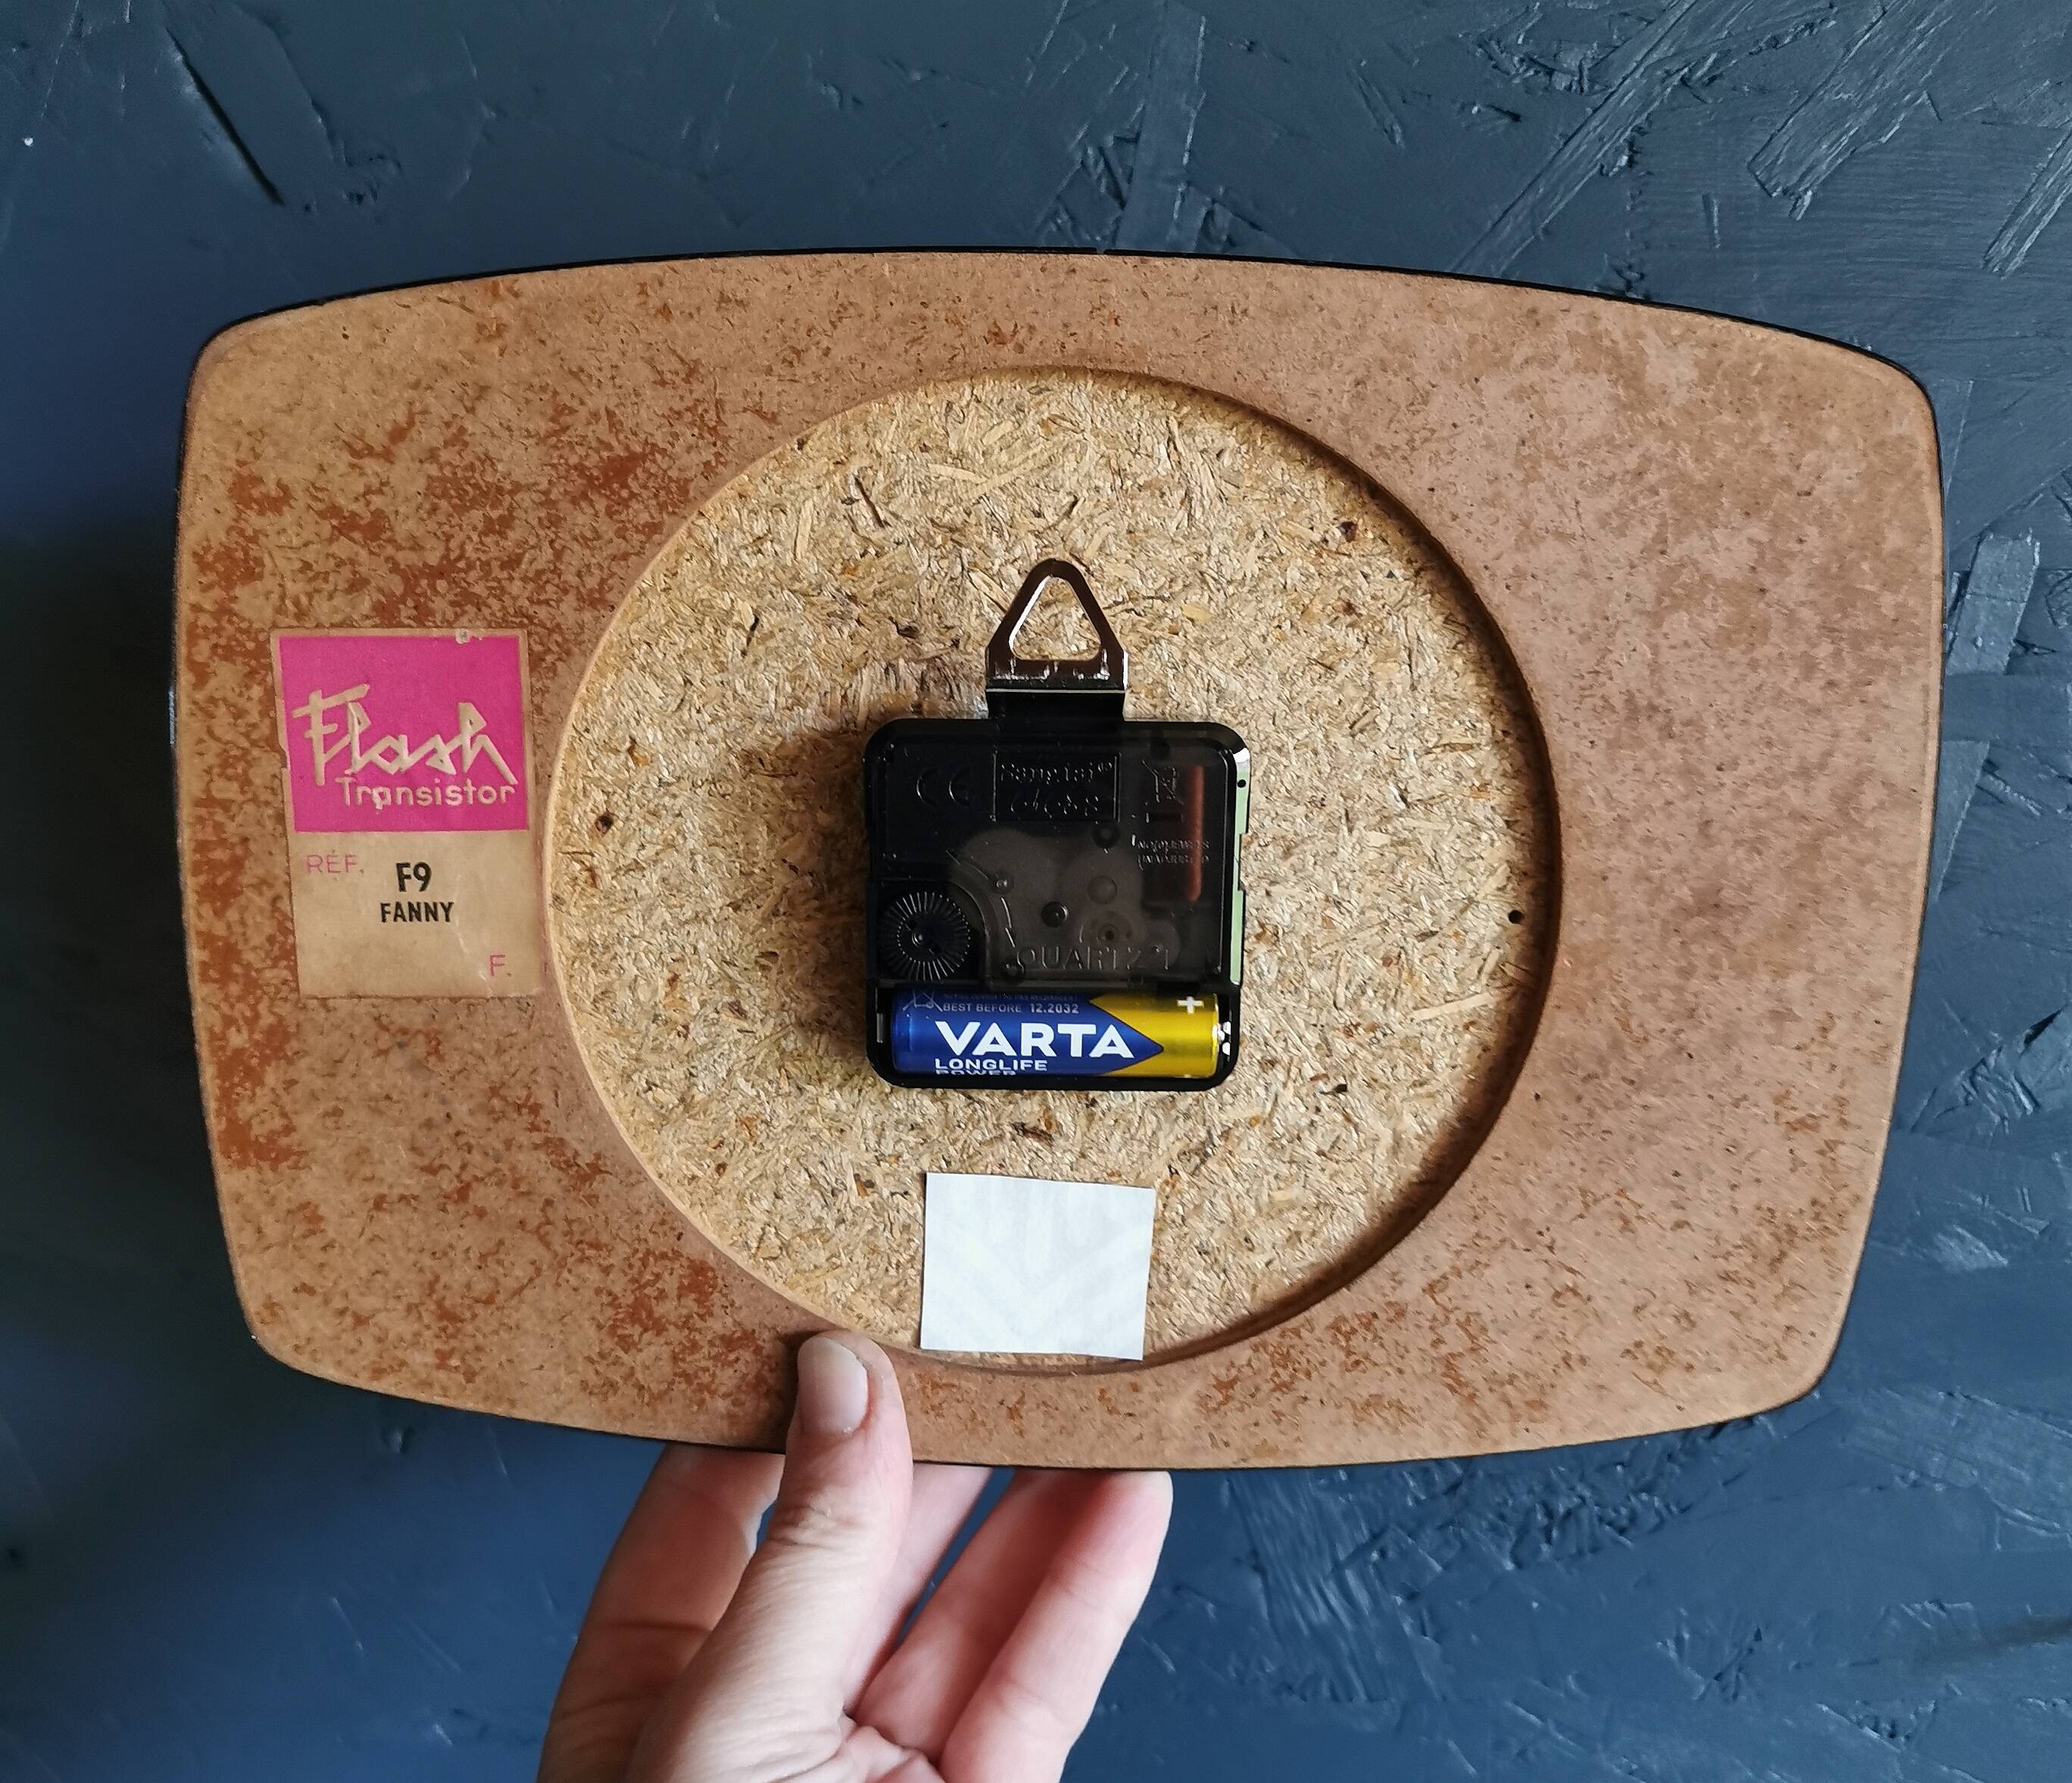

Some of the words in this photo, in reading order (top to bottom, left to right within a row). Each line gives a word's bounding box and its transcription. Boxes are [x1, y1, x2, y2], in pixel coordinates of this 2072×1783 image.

[292, 683, 520, 787] Flash
[335, 776, 516, 809] Transistor
[395, 862, 432, 893] F9
[380, 901, 454, 923] FANNY
[943, 1003, 971, 1013] BEST
[976, 1003, 1022, 1013] BEFORE
[1029, 1002, 1079, 1015] 12.2032
[935, 1021, 1134, 1059] VARTA
[935, 1058, 1048, 1071] LONGLIFE
